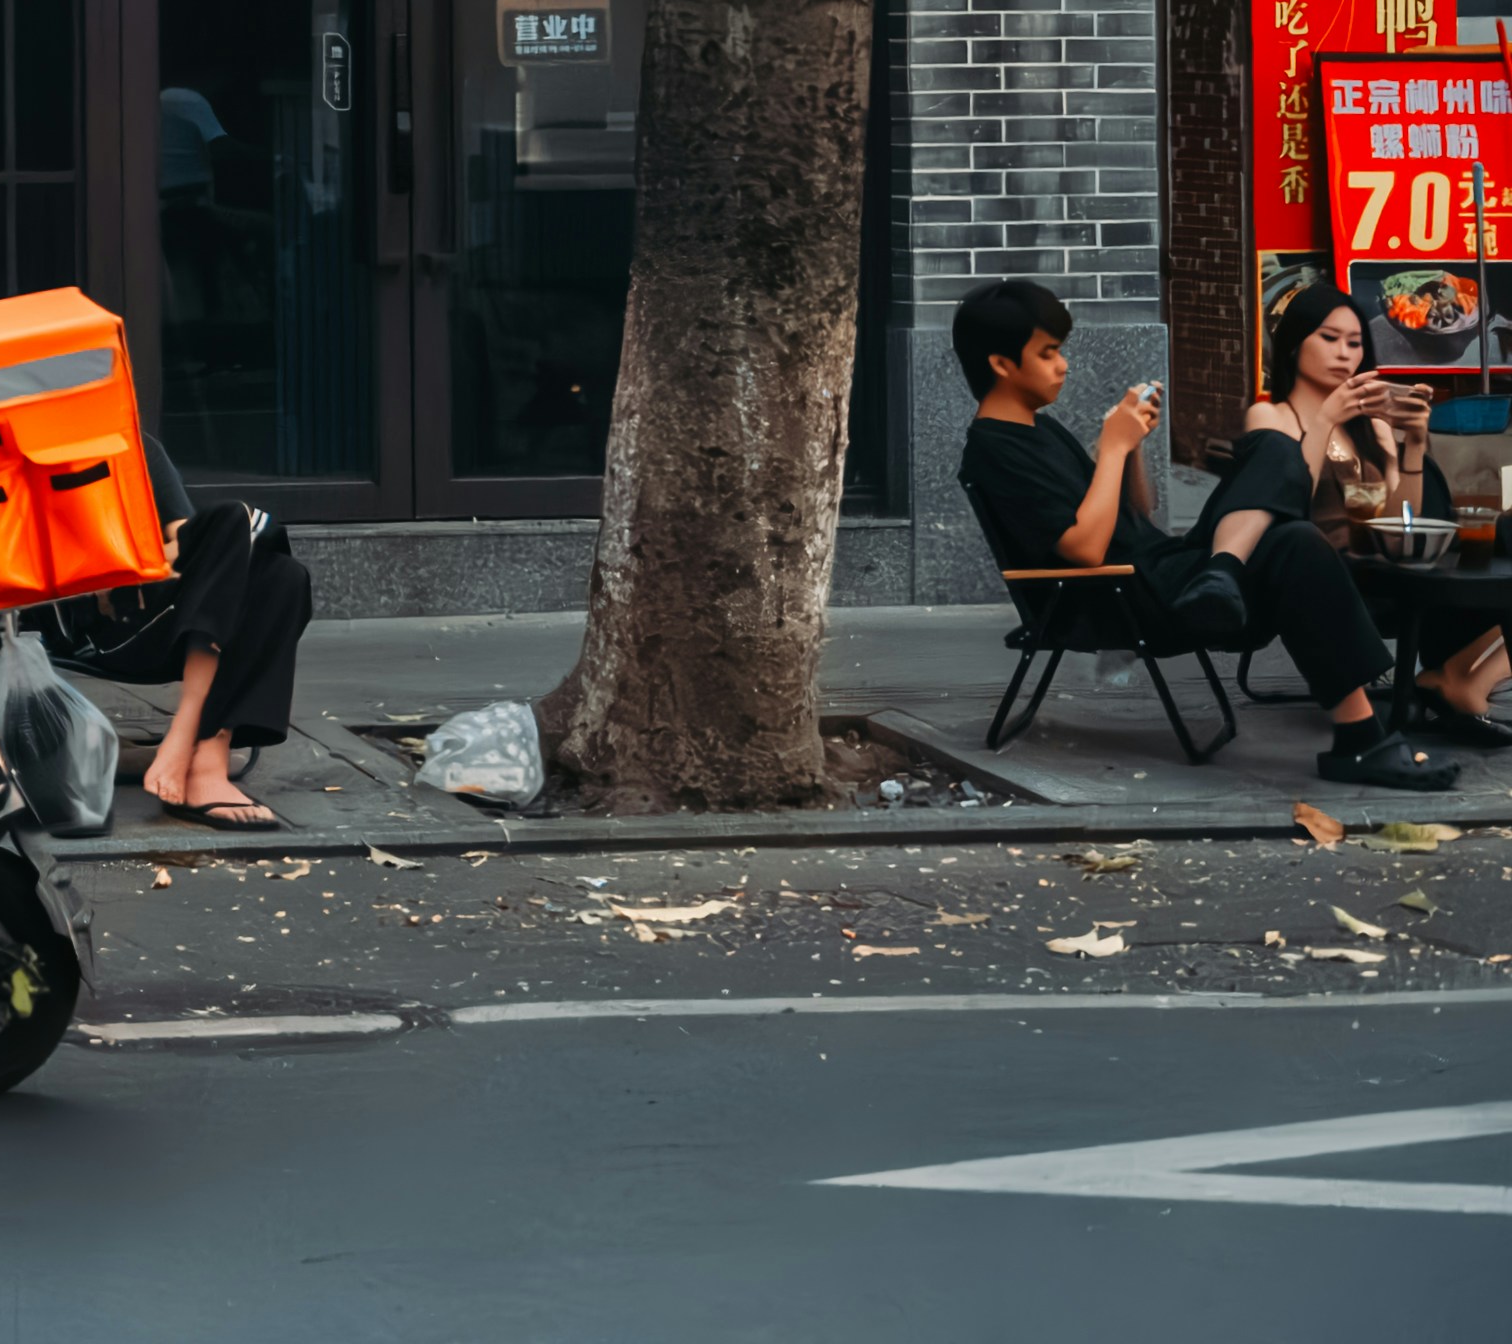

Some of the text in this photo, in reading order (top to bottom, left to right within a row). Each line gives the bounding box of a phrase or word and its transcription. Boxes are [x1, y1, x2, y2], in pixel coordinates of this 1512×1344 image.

[514, 13, 596, 42] 营业中
[1331, 78, 1512, 115] 正宗柳州味
[1370, 123, 1480, 160] 螺蛳粉
[1347, 170, 1451, 252] 7.0
